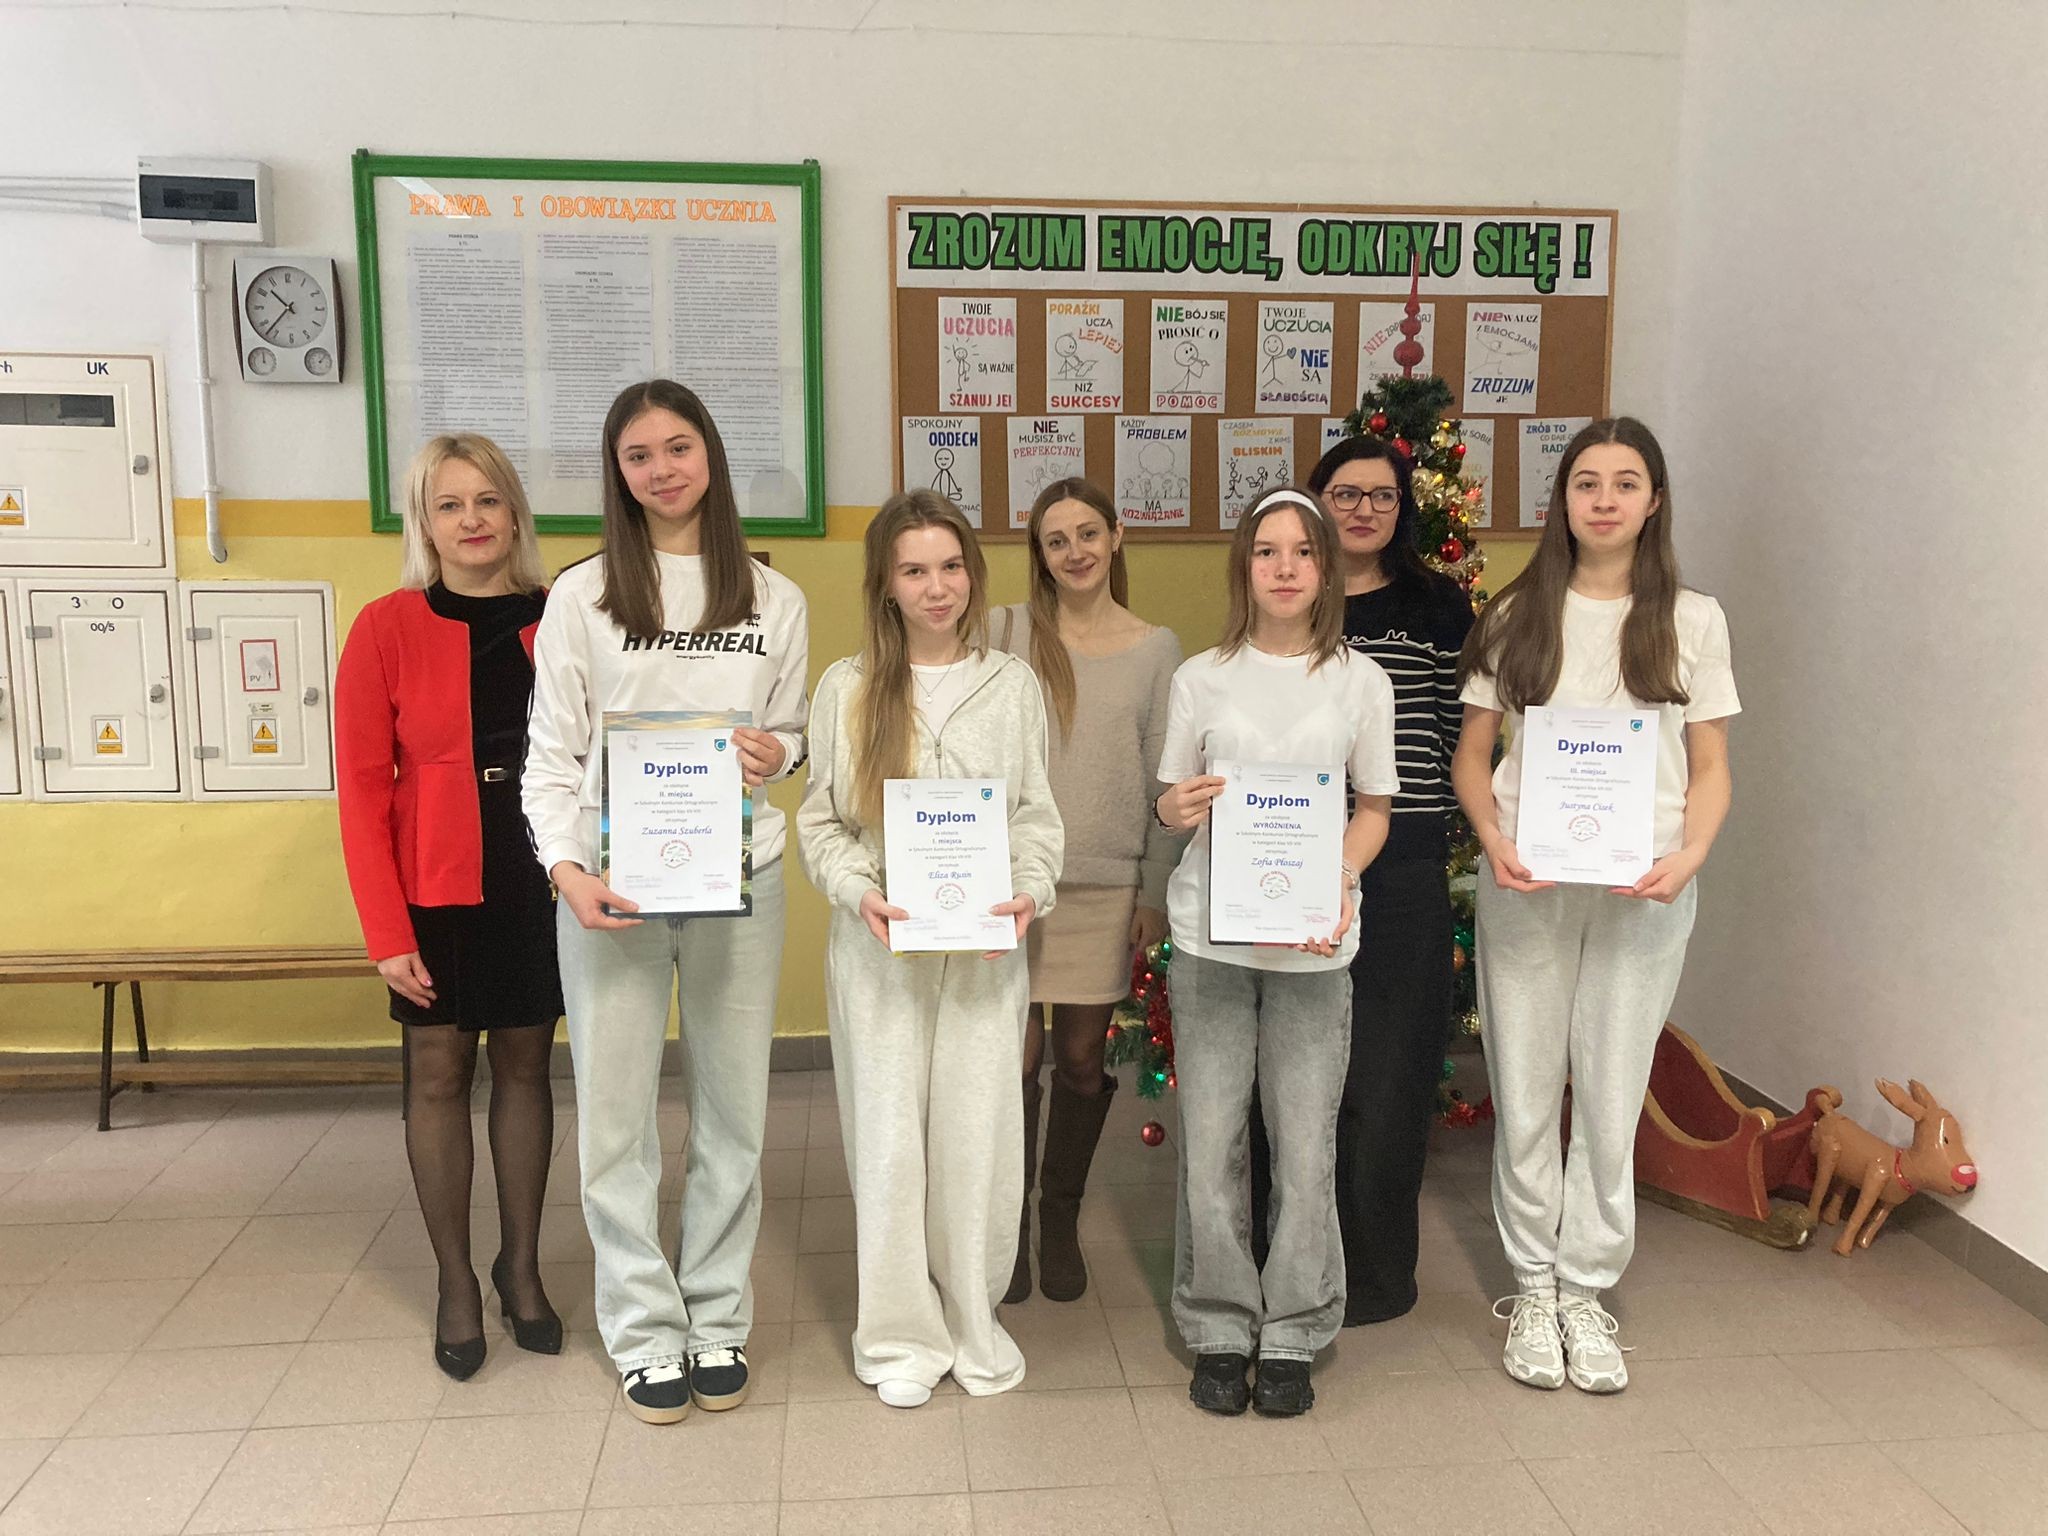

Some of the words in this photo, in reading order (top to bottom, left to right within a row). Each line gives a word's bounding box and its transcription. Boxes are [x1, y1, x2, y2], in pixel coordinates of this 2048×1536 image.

[409, 194, 491, 216] PRAWA
[513, 196, 524, 216] I
[541, 195, 676, 223] OBOWIĄZKI
[686, 198, 776, 222] UCZNIA
[908, 212, 1086, 271] ZROZUM
[1097, 215, 1283, 281] EMOCJE,
[1298, 219, 1462, 278] ODKRYJ
[1473, 222, 1561, 294] SIŁĘ
[1573, 224, 1594, 279] !
[962, 303, 992, 315] TWOJE
[1049, 301, 1100, 315] PORAŻKI
[1156, 306, 1184, 323] NIE
[1185, 309, 1208, 320] BÓJ
[1209, 310, 1226, 323] SIĘ
[1264, 307, 1306, 318] TWOJE
[944, 317, 1015, 337] UCZUCIA
[1086, 318, 1113, 328] UCZĄ
[1264, 319, 1332, 333] UCZUCIA
[1158, 326, 1205, 340] PROSIĆ
[1209, 329, 1219, 340] O
[1483, 324, 1538, 352] EMOCJAMI
[1078, 327, 1124, 354] LEPIEJ
[1362, 330, 1388, 356] NIE
[87, 362, 109, 375] UK
[978, 364, 988, 375] SĄ
[989, 362, 1015, 374] WAŻNE
[1074, 381, 1093, 392] NIŻ
[1471, 377, 1535, 395] ZROZUM
[949, 393, 992, 407] SZANUJ
[1051, 395, 1121, 408] SUKCESY
[1156, 395, 1218, 409] POMOC
[907, 418, 963, 429] SPOKOJNY
[1033, 420, 1059, 434] NIE
[1121, 418, 1146, 428] KAŻDY
[1526, 422, 1551, 434] ZRÓB
[1553, 424, 1567, 433] TO
[928, 431, 978, 447] ODDECH
[1019, 434, 1054, 443] MUSISZ
[1056, 433, 1076, 443] BYĆ
[1127, 428, 1187, 440] PROBLEM
[1013, 445, 1081, 458] PERFEKCYJNY
[1232, 446, 1283, 457] BLISKIM
[1145, 500, 1162, 511] MA
[621, 629, 767, 657] HYPERREAL
[1558, 739, 1622, 755] Dyplom
[644, 762, 708, 778] Dyplom
[1246, 793, 1310, 809] Dyplom
[916, 811, 976, 825] Dyplom
